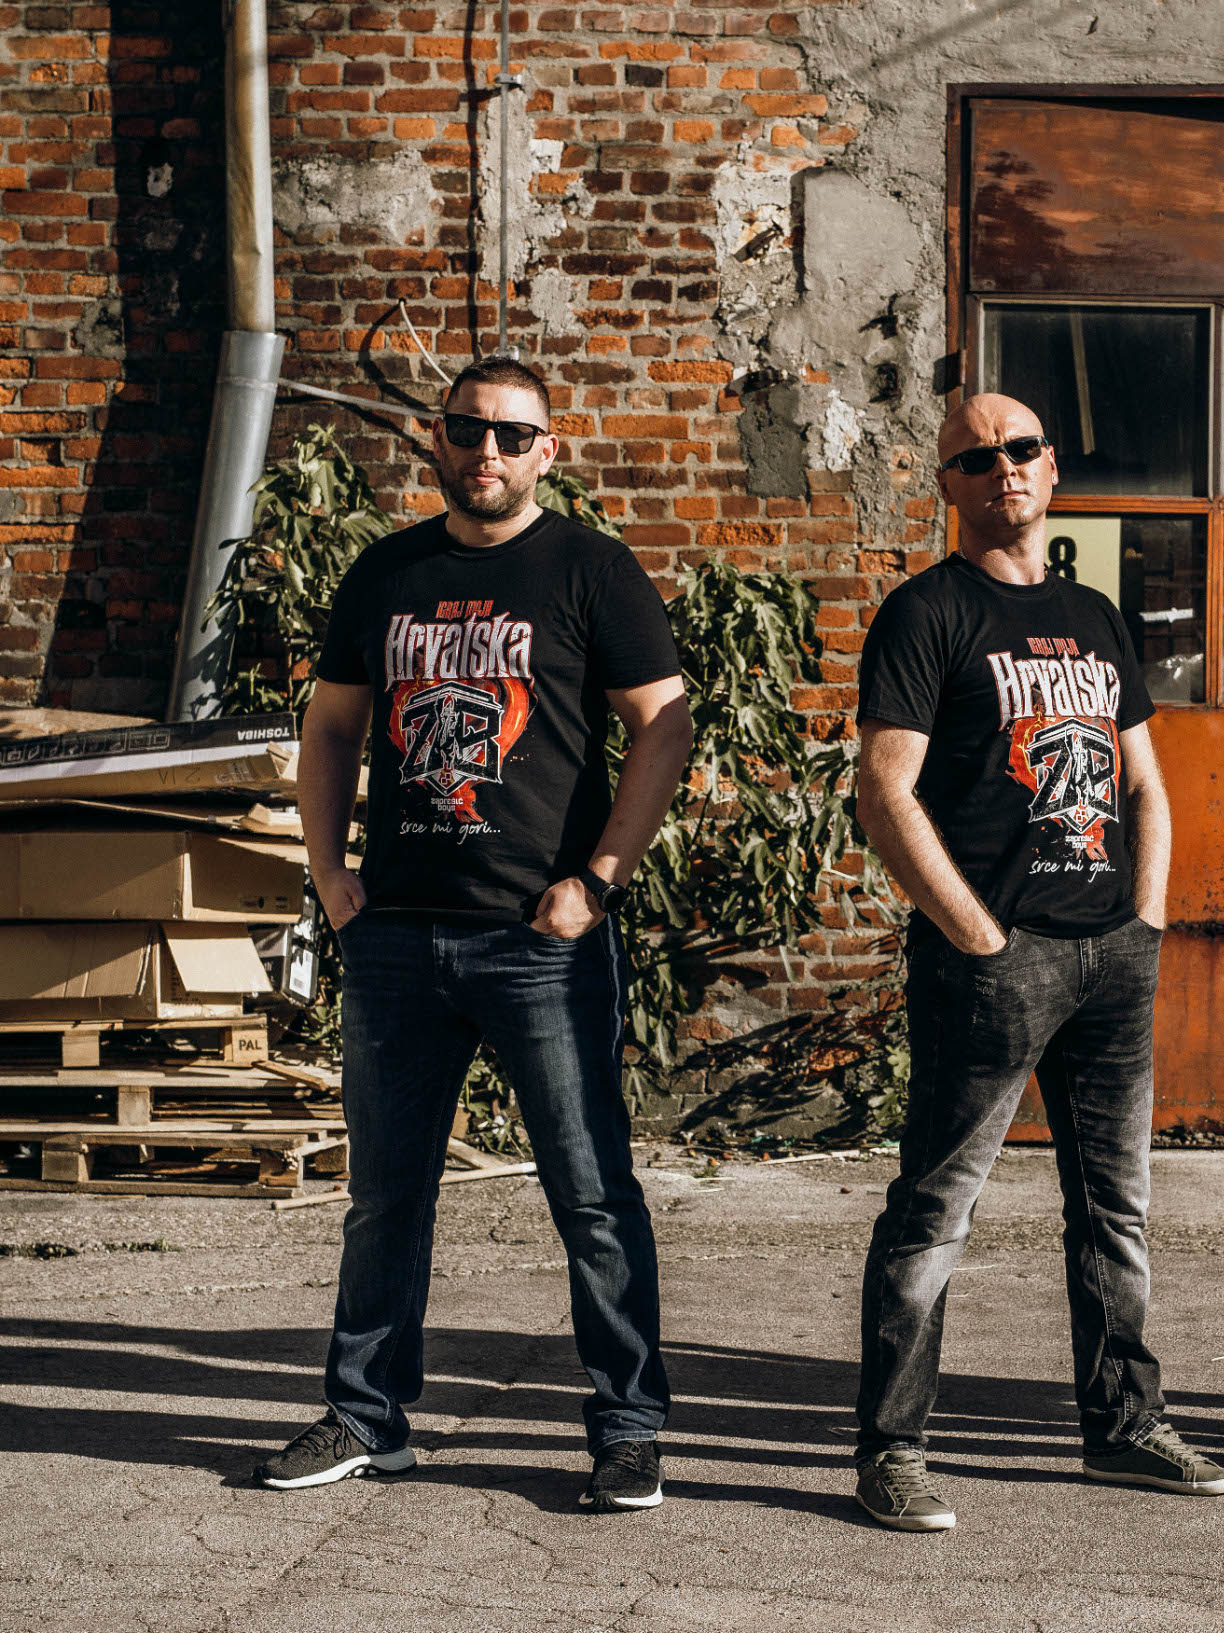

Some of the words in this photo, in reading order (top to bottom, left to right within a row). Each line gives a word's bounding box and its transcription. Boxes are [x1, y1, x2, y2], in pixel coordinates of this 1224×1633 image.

[384, 611, 533, 692] Hrvatska
[986, 650, 1121, 732] Hrvatska
[237, 727, 290, 741] TOSHIBA
[400, 821, 428, 835] srce
[432, 821, 453, 833] mi
[1029, 860, 1061, 875] srce
[1064, 859, 1084, 872] mi
[239, 1039, 264, 1051] PAL
